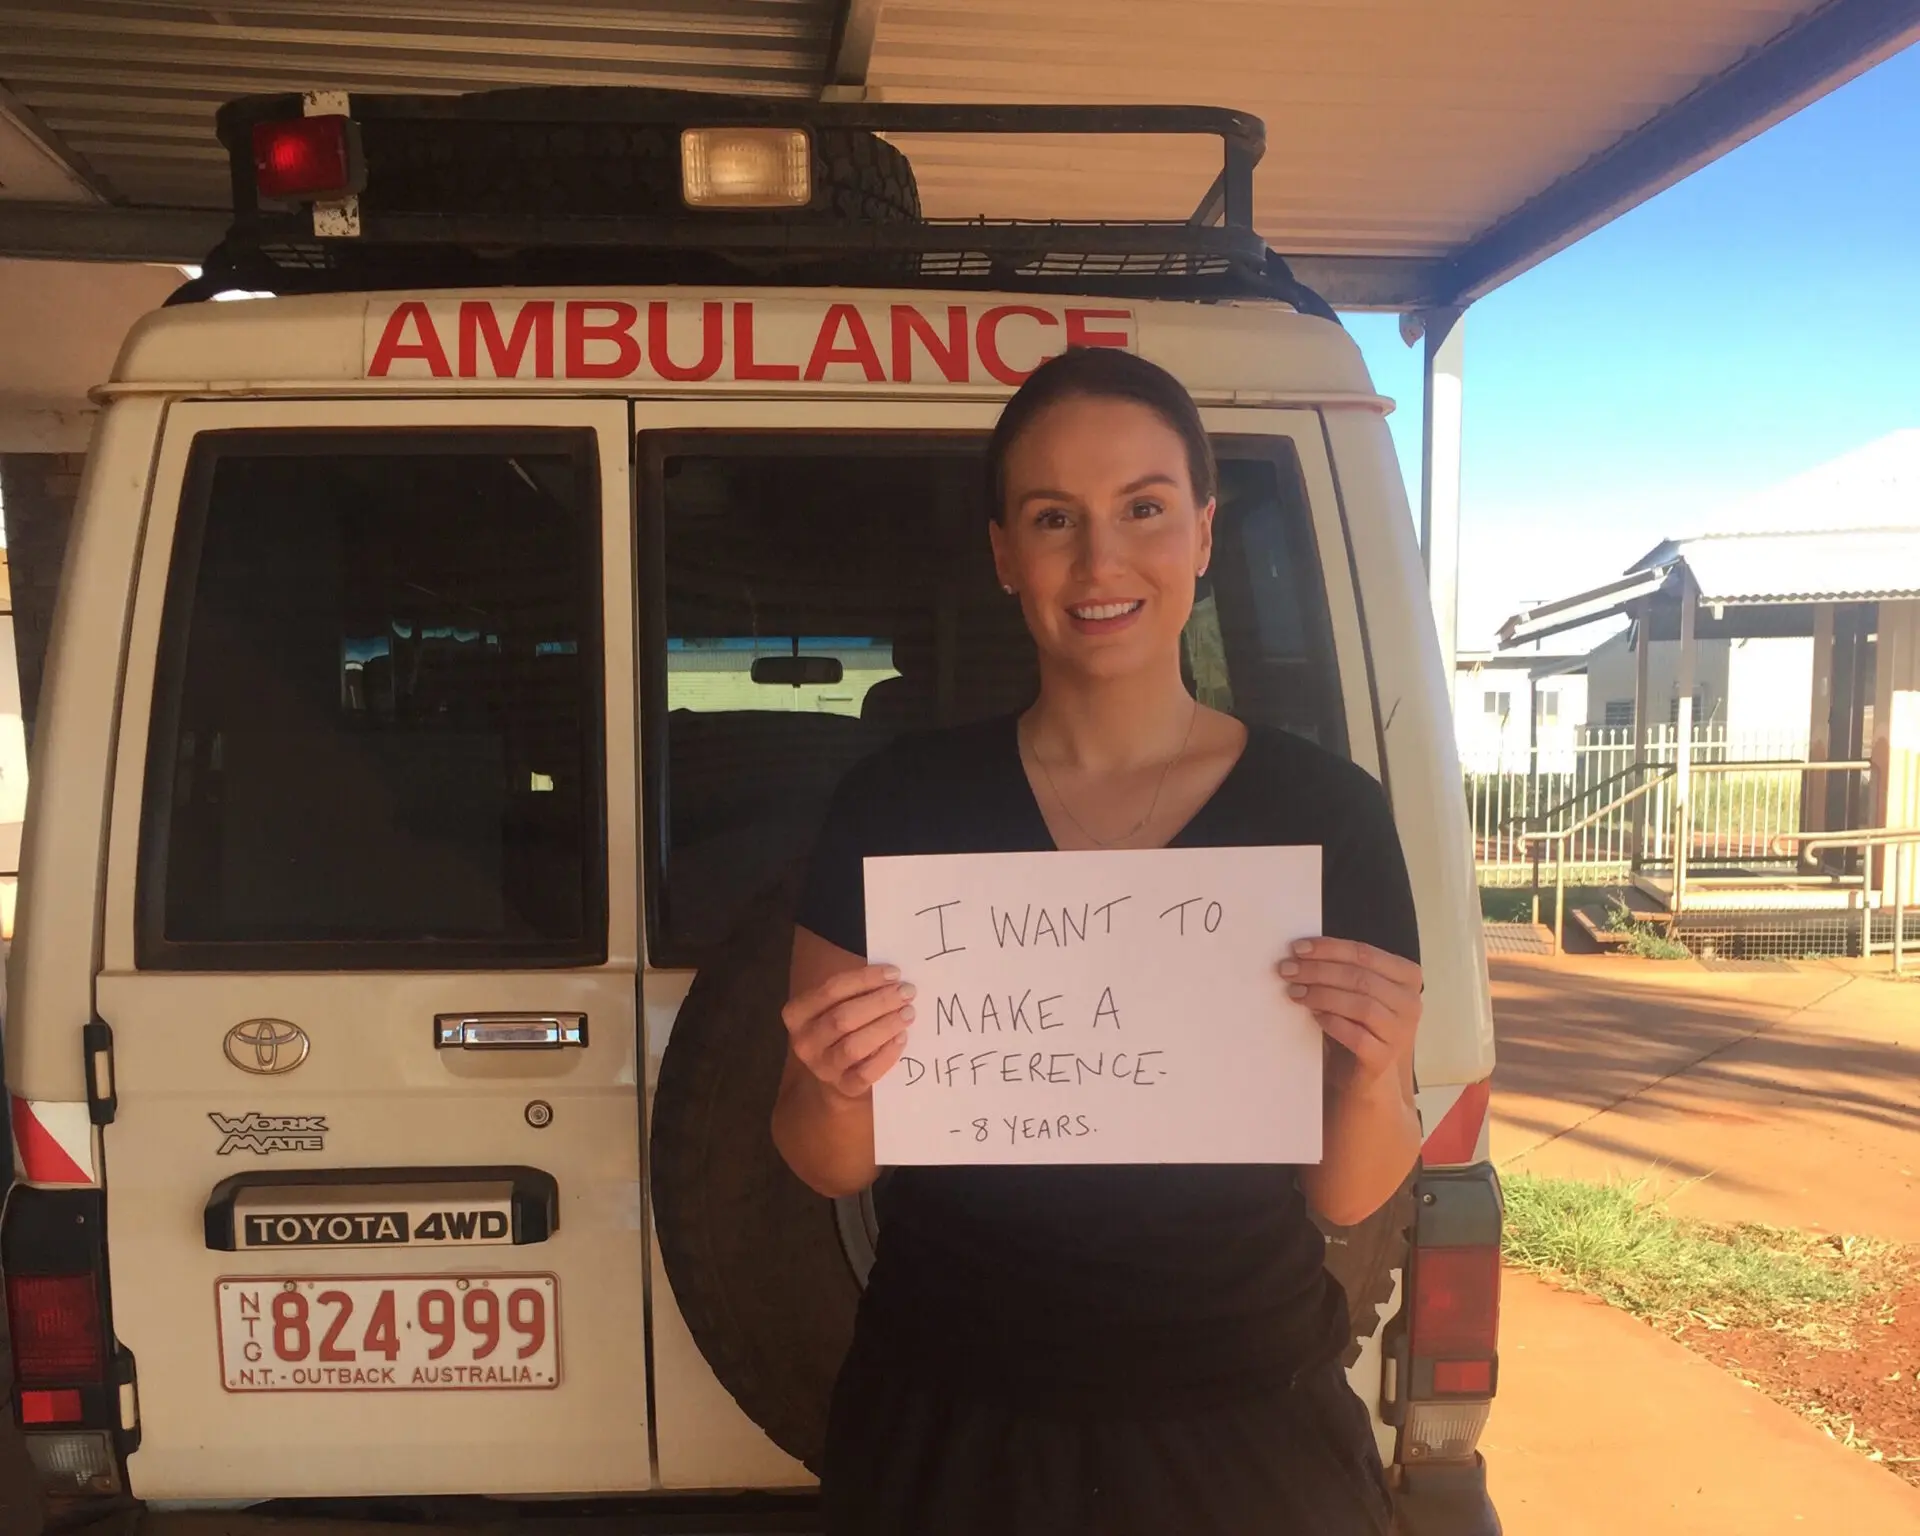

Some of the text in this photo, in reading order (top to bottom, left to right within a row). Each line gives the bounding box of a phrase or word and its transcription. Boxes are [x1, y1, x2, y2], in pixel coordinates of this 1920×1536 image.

[915, 895, 1222, 961] I WANT TO
[936, 986, 1121, 1035] MAKE A
[207, 1112, 329, 1133] WORK
[1002, 1114, 1099, 1145] YEARS.
[217, 1134, 324, 1155] MATE
[253, 1210, 509, 1242] TOYOTA 4WD
[292, 1367, 395, 1384] OUTBACK
[411, 1365, 532, 1384] AUSTRALIA
